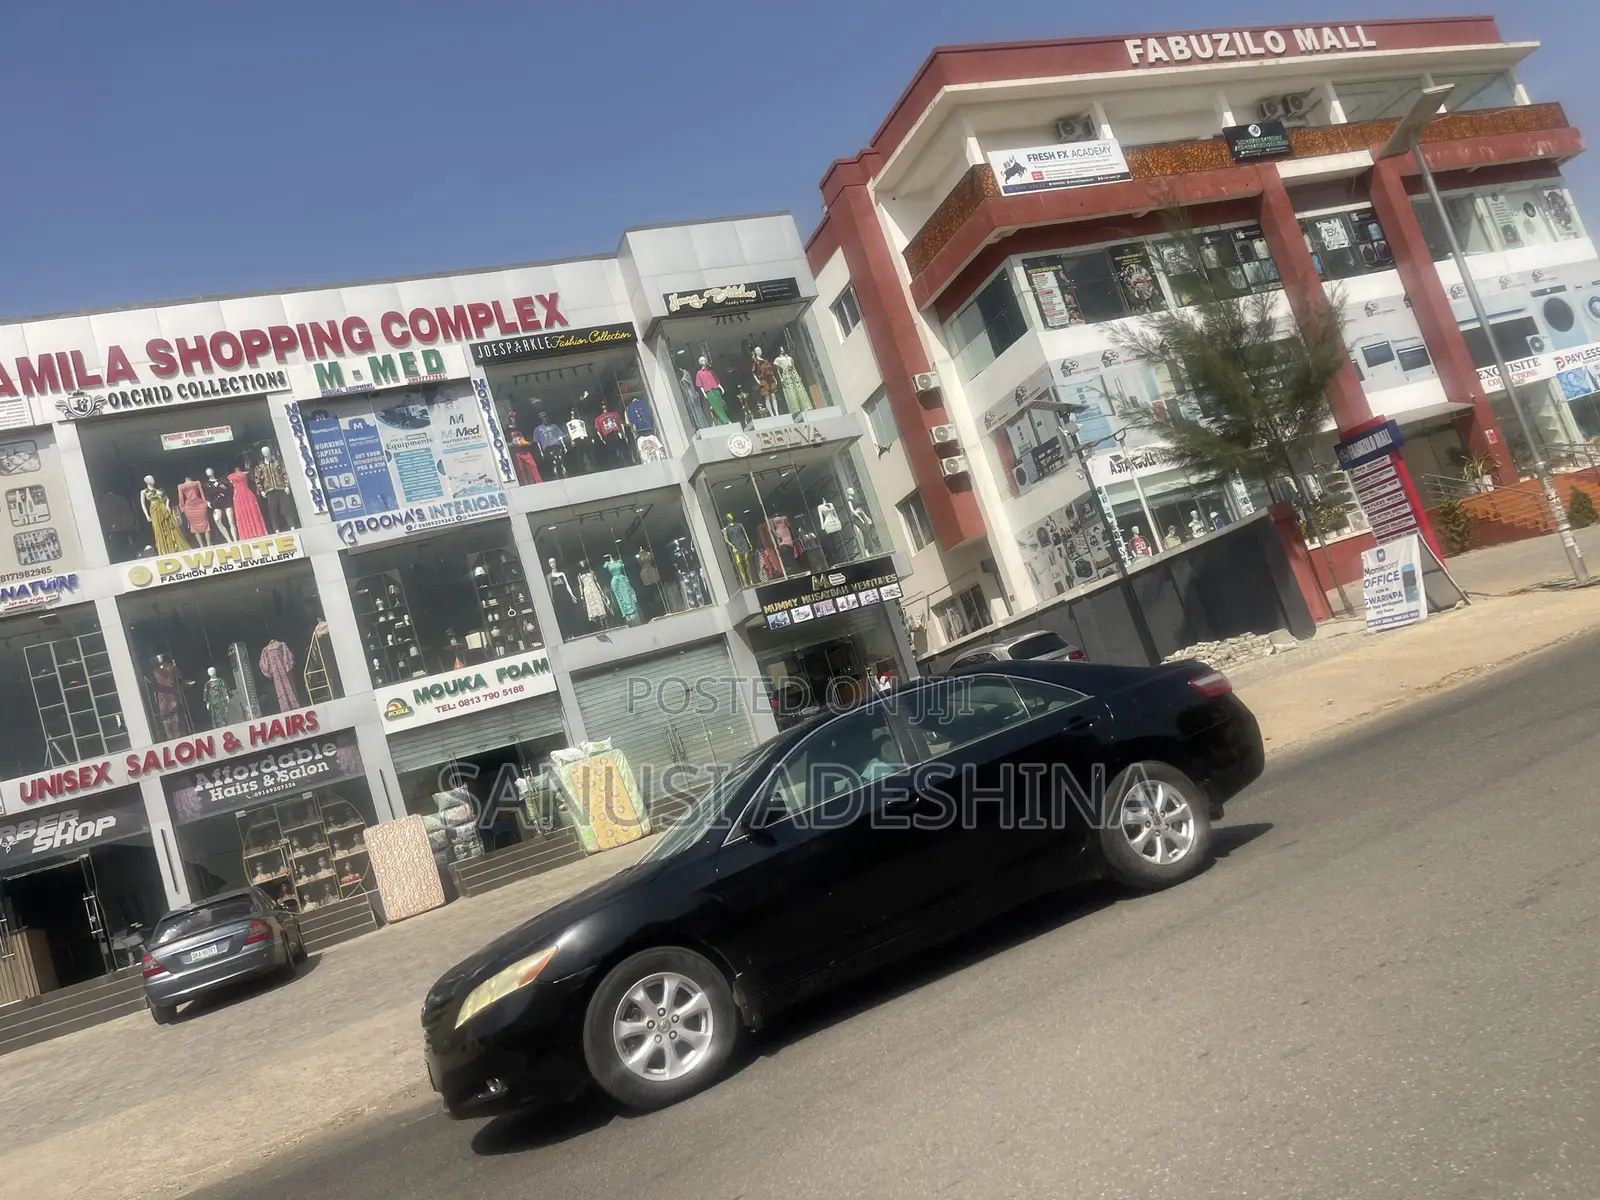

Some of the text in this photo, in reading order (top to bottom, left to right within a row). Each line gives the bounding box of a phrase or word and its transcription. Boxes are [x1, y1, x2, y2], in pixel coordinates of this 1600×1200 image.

[1124, 25, 1377, 65] FABUZILO MALL
[1027, 145, 1112, 162] FRESH FX ACADEMY
[145, 317, 374, 378] SHOPPING
[380, 292, 569, 347] COMPLEX
[478, 329, 632, 359] JOESPARKLE Fashion Collection
[1478, 357, 1541, 379] EXISITE
[1488, 369, 1537, 387] COLCTIONS
[107, 370, 288, 410] ORCHID COLLECTIONS
[315, 440, 345, 450] WORKING
[386, 437, 433, 450] Equipments
[355, 493, 509, 535] BOONA'S INTERIORS
[155, 535, 297, 577] DWHITE
[160, 551, 296, 584] FASHION AND JEWELLERY
[763, 598, 798, 614] MUMMY
[850, 573, 898, 592] VENTURES
[1363, 570, 1400, 590] OFFICE
[412, 657, 551, 707] MOUKA FOAM
[435, 684, 525, 714] TEL: 0813 790 5188
[19, 709, 321, 805] UNISEX SALON & HAIRS
[193, 741, 338, 793] Affordable
[209, 761, 329, 802] Hairs & Salon
[32, 815, 117, 854] SHOP
